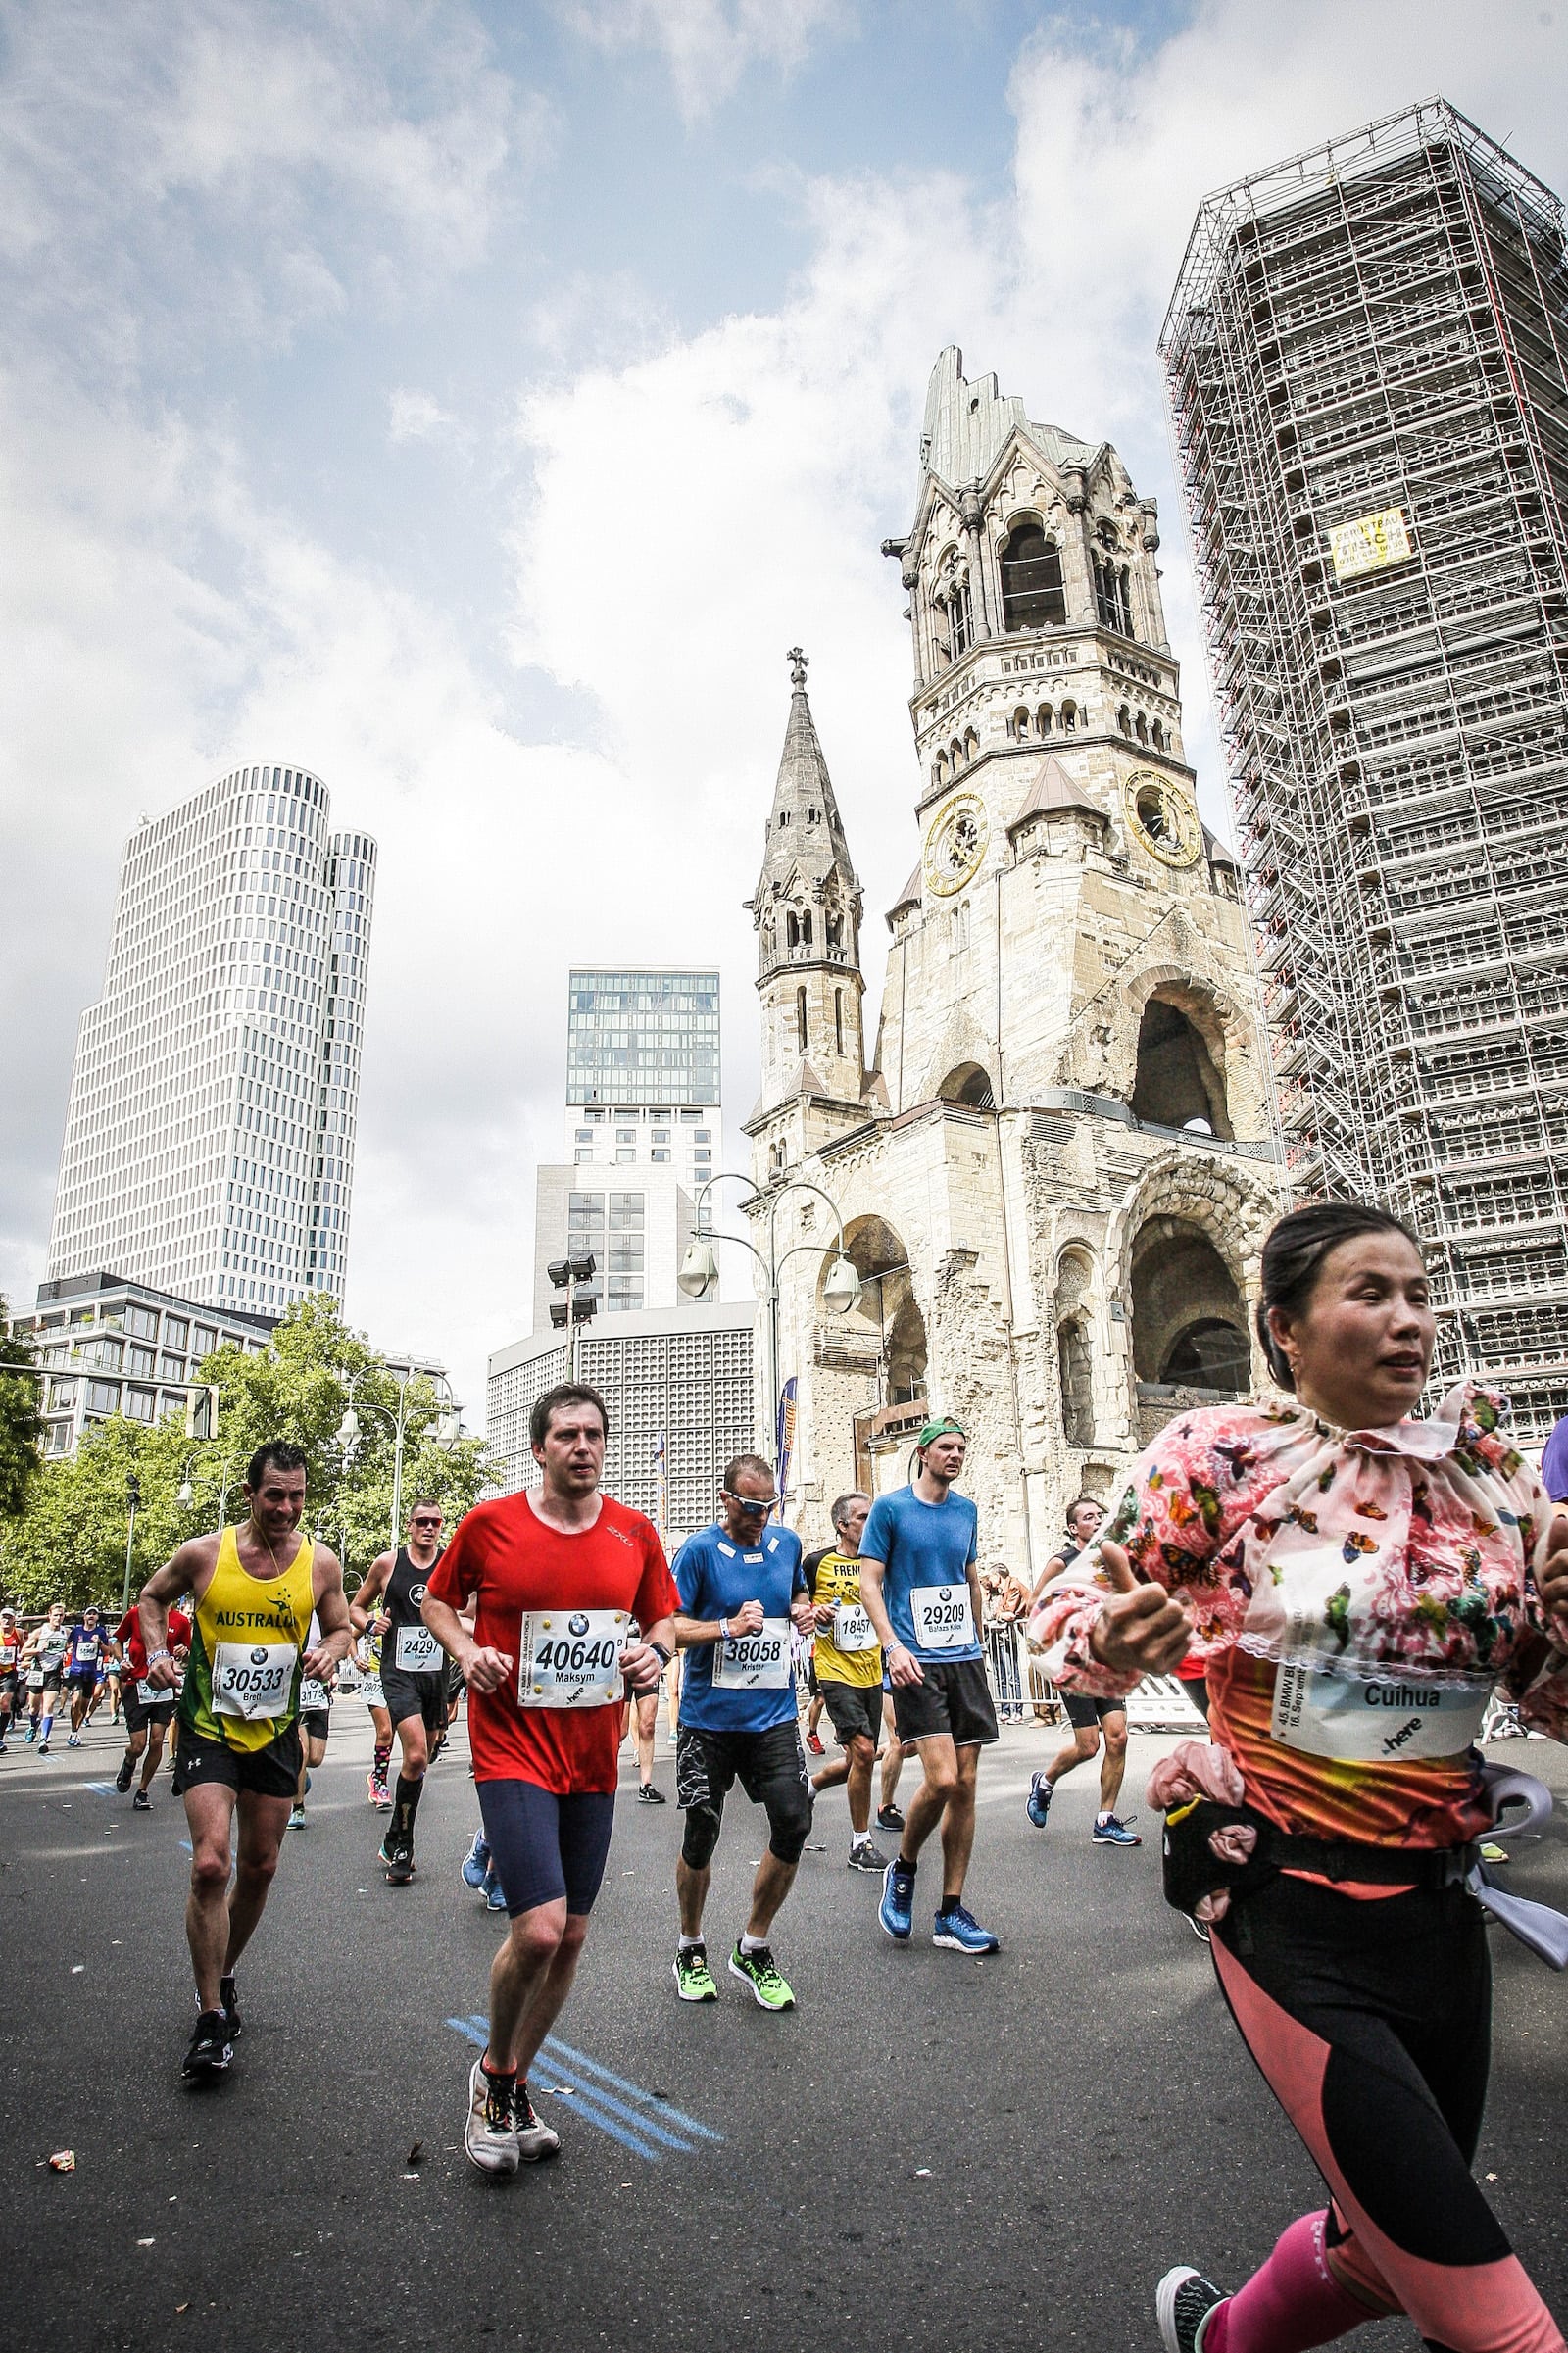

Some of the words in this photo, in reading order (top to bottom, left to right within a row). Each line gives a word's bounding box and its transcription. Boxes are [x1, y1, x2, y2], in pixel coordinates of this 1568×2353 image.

[216, 1611, 296, 1628] AUSTRALIA
[923, 1603, 964, 1625] 29209
[842, 1619, 870, 1635] 18457
[404, 1640, 438, 1654] 24297
[617, 1639, 623, 1647] D
[725, 1641, 781, 1663] 38058
[535, 1640, 615, 1671] 40640
[223, 1667, 284, 1691] 30533
[555, 1672, 595, 1685] Maksym
[1280, 1680, 1293, 1708] BMW
[1364, 1684, 1441, 1708] Cuihua
[1279, 1710, 1289, 1725] 45.
[1383, 1717, 1423, 1751] here
